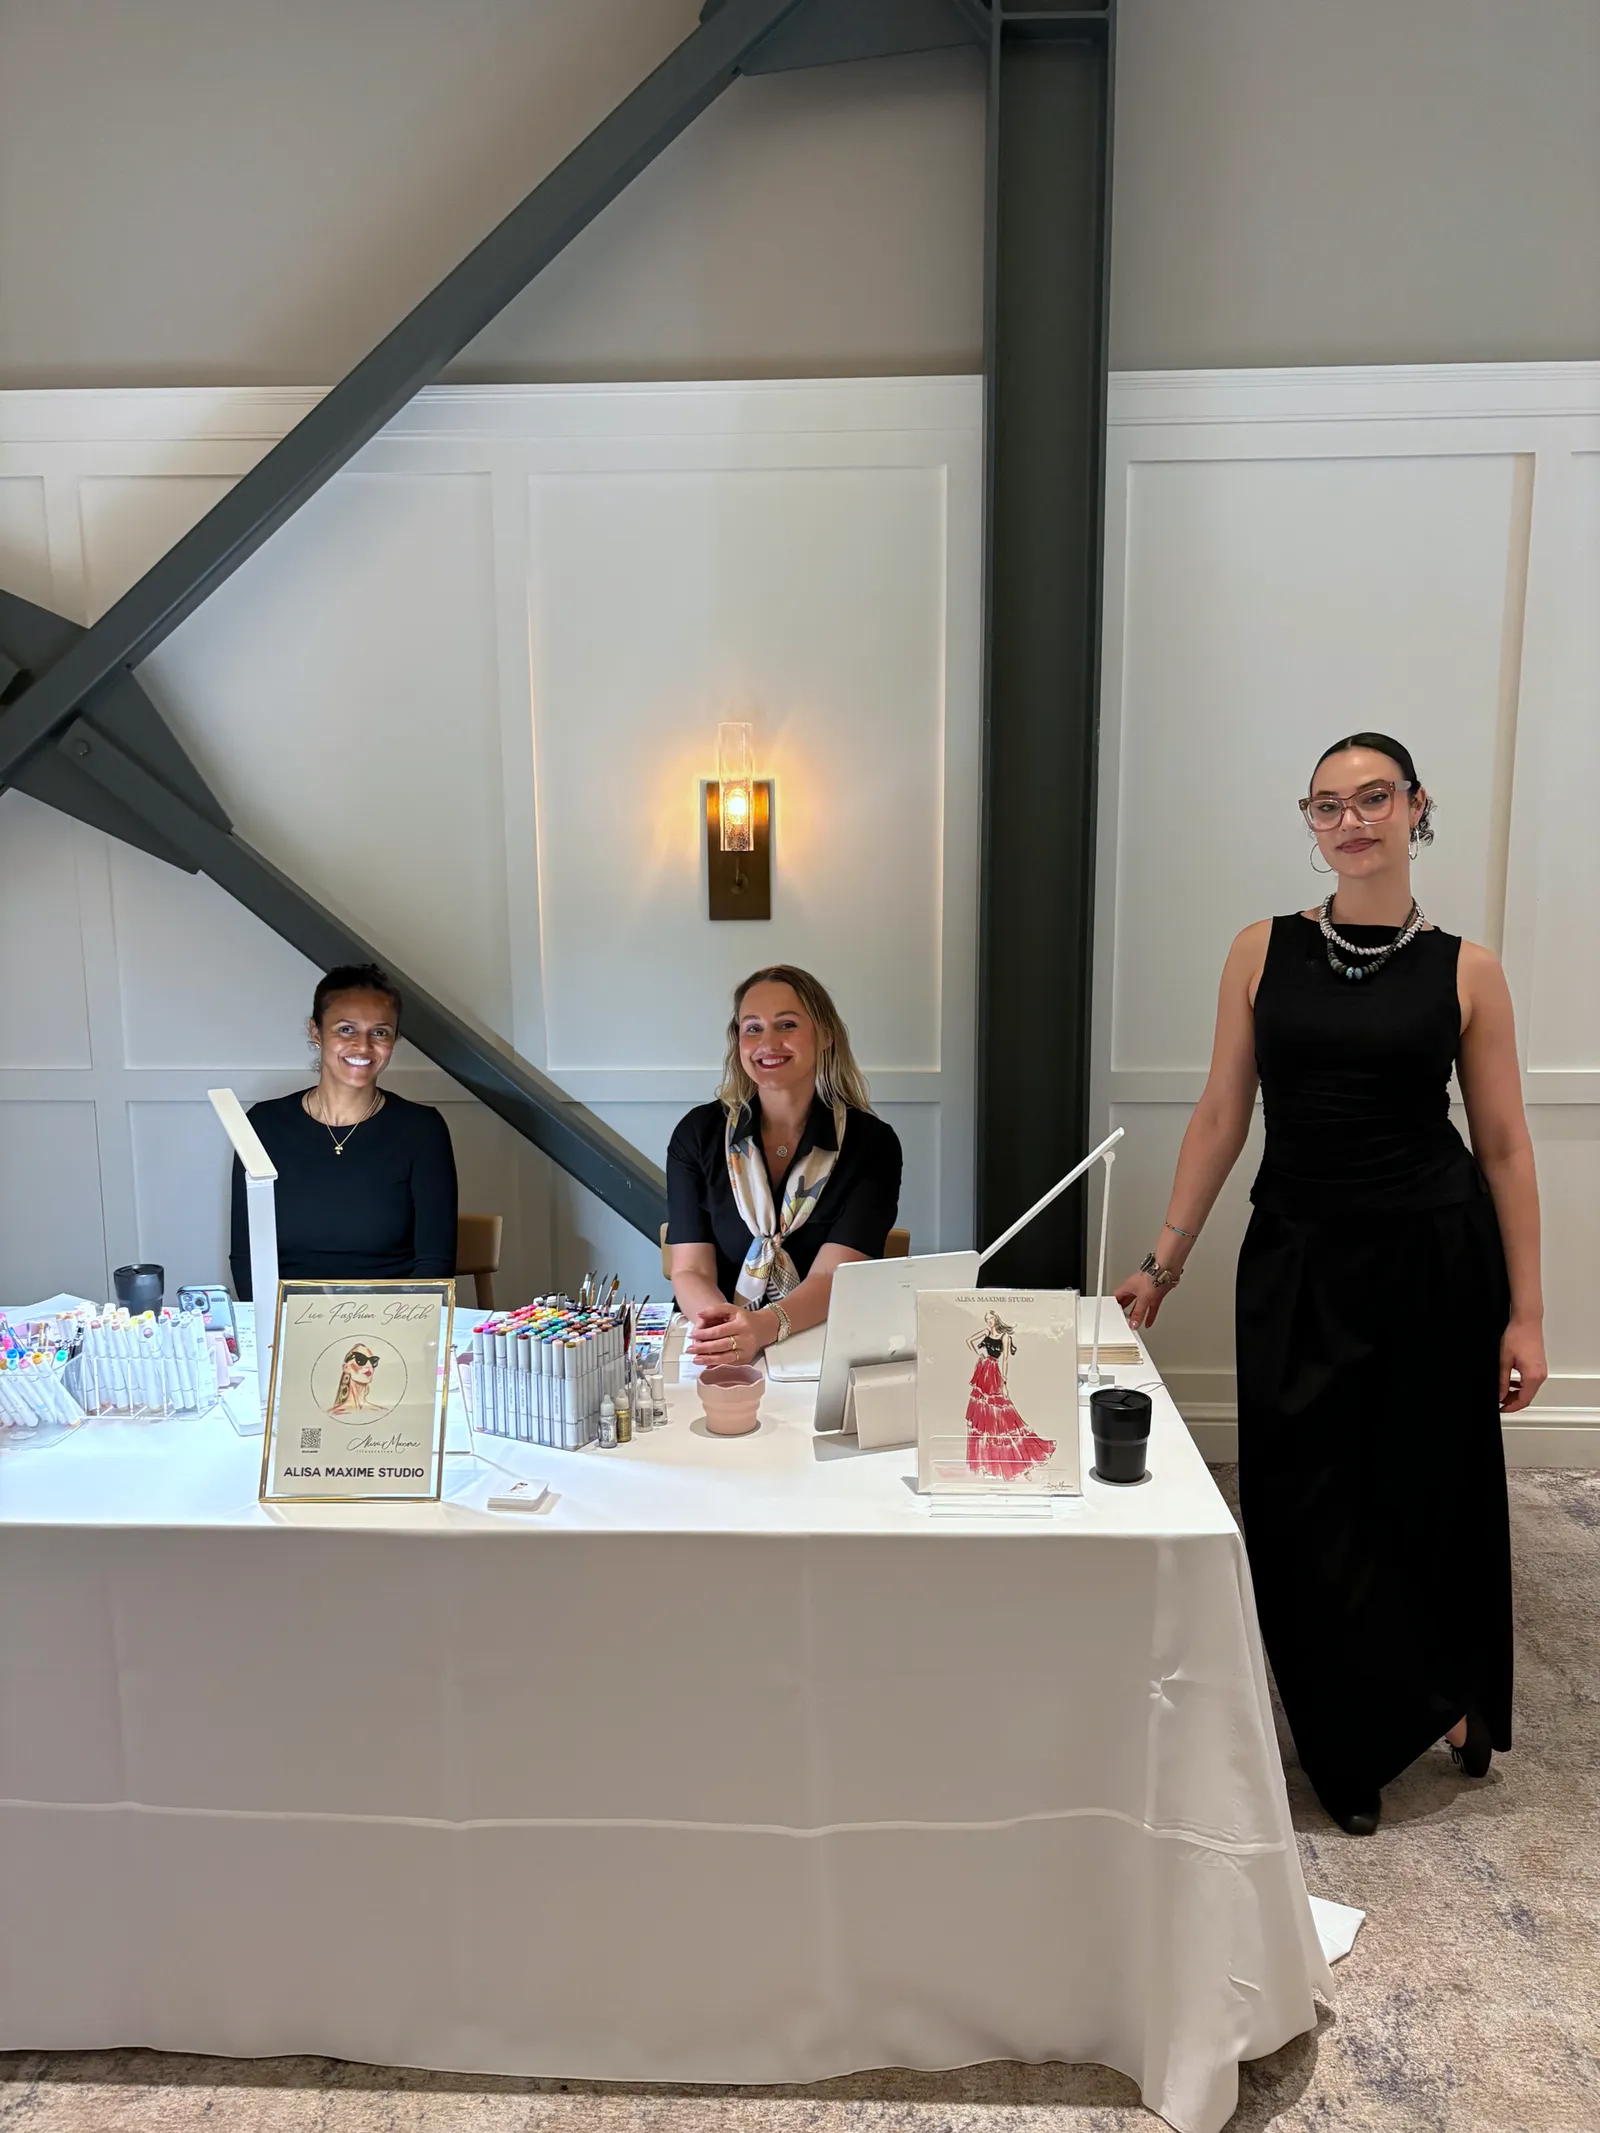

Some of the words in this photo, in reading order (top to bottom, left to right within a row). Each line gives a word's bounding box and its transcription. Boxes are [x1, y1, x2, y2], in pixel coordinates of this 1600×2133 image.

[328, 1301, 376, 1325] Fashion
[380, 1301, 435, 1326] Sketch
[283, 1466, 322, 1478] ALISA
[325, 1467, 375, 1478] MAXIME
[378, 1467, 425, 1478] STUDIO
